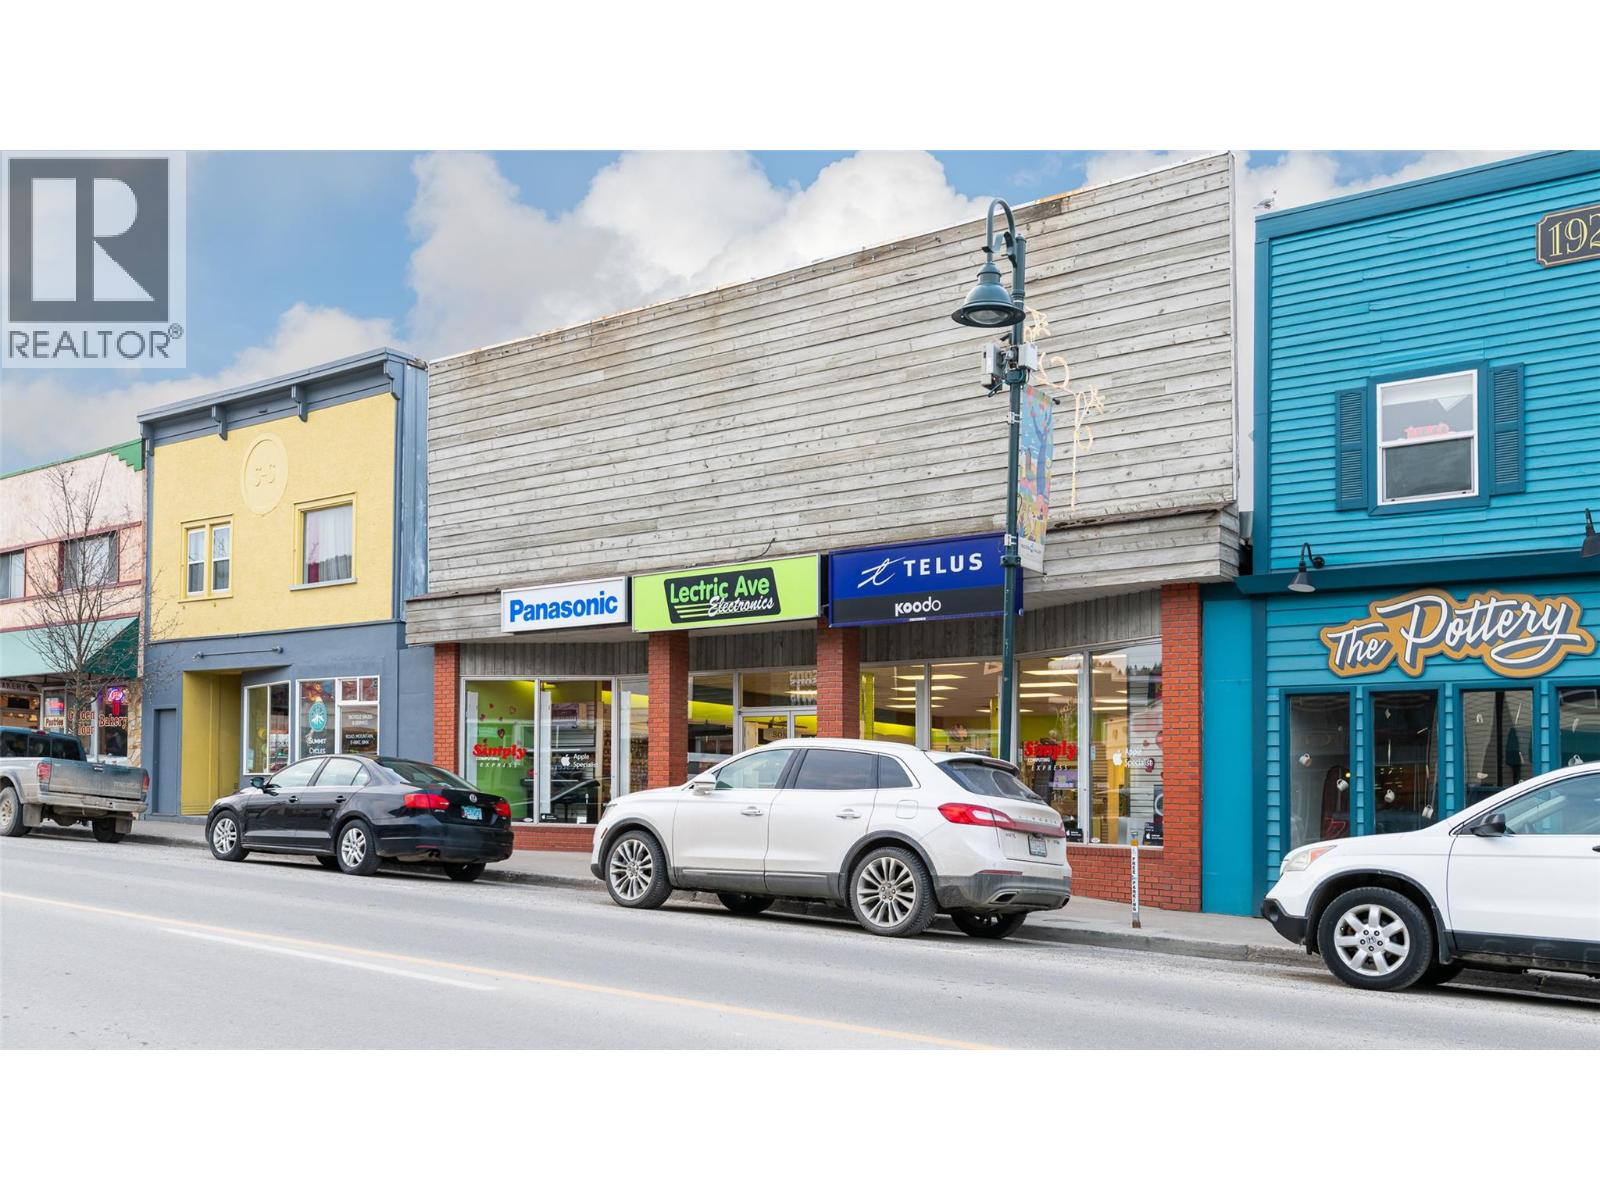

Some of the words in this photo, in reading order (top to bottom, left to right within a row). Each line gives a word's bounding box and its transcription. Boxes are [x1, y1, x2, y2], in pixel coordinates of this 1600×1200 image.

[903, 552, 983, 577] TELUS
[670, 577, 729, 604] Lectric
[734, 575, 770, 597] Ave
[509, 590, 618, 623] Panasonic
[707, 595, 775, 617] Electronics
[1326, 622, 1389, 666] The
[1375, 594, 1582, 665] Pottery
[98, 714, 128, 729] Bakery
[472, 743, 526, 760] Simply
[1024, 739, 1078, 761] Simply
[1124, 757, 1153, 768] Specialist
